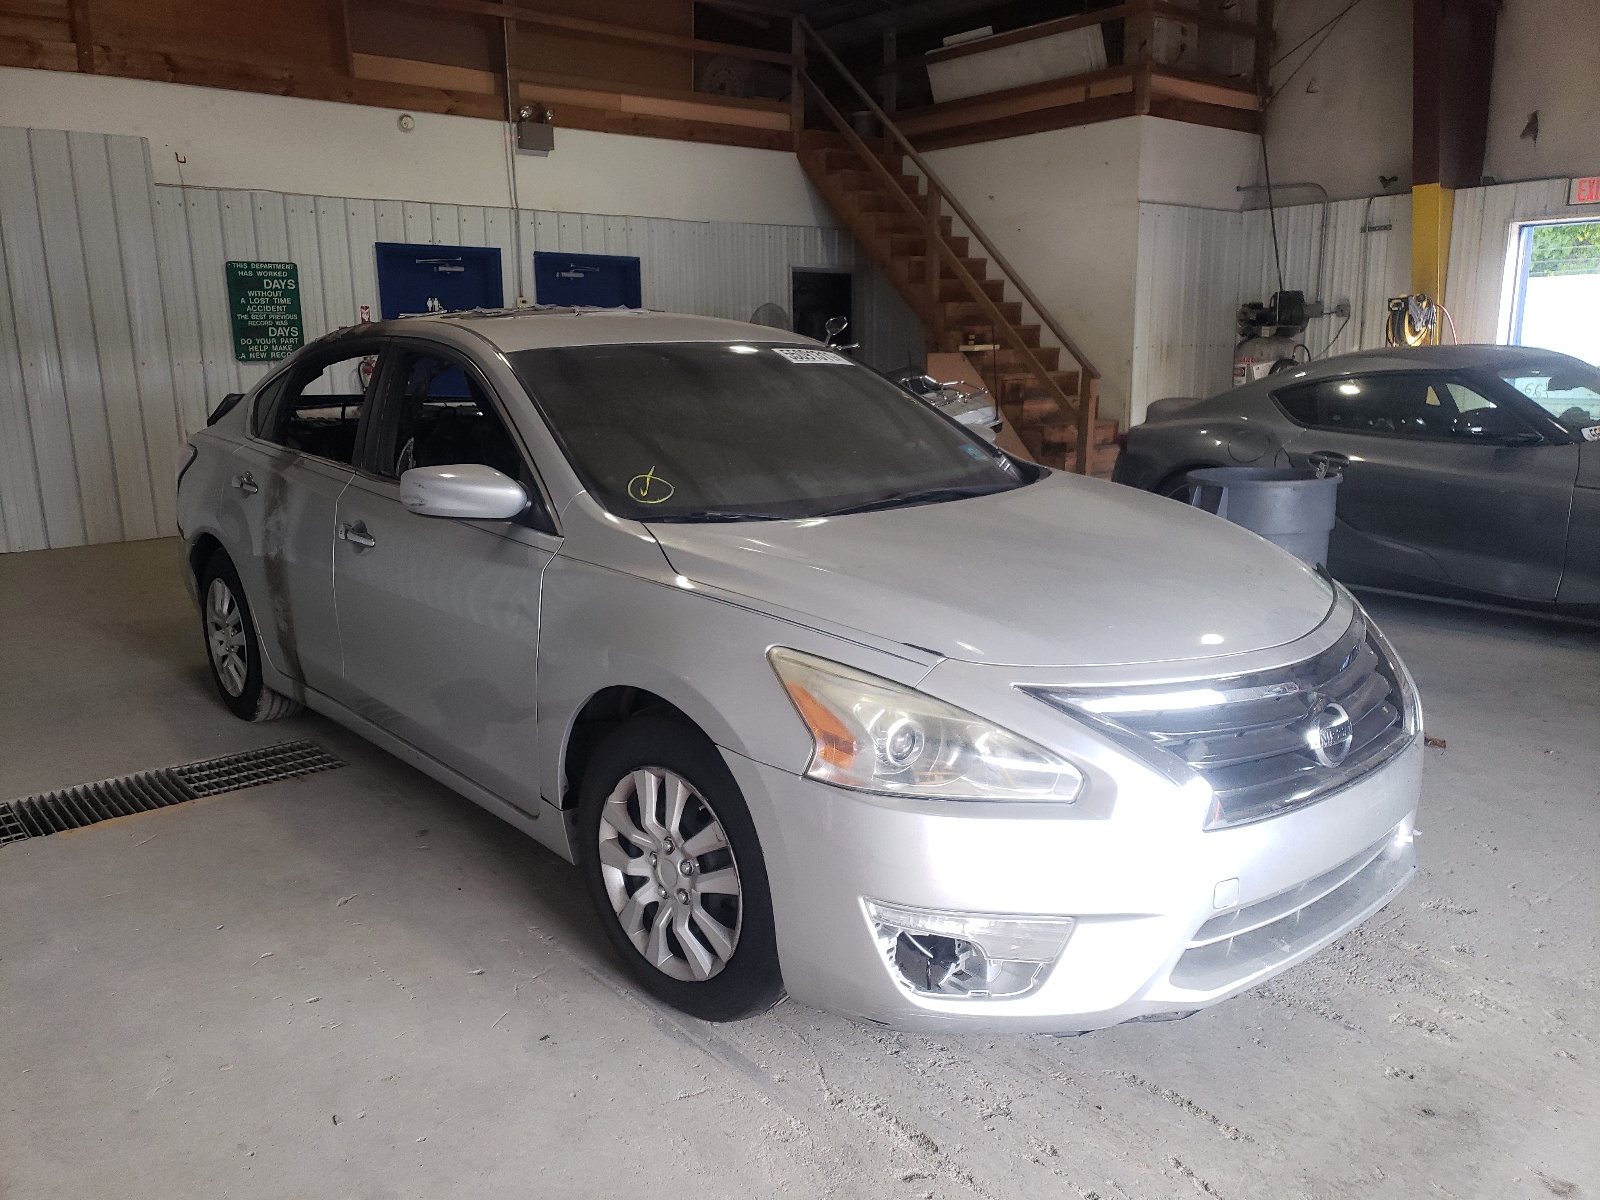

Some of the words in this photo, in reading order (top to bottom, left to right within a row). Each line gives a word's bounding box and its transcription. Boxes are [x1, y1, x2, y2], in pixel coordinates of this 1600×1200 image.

[1578, 178, 1600, 202] EXI
[263, 279, 296, 290] DAYS
[268, 327, 299, 337] DAYS
